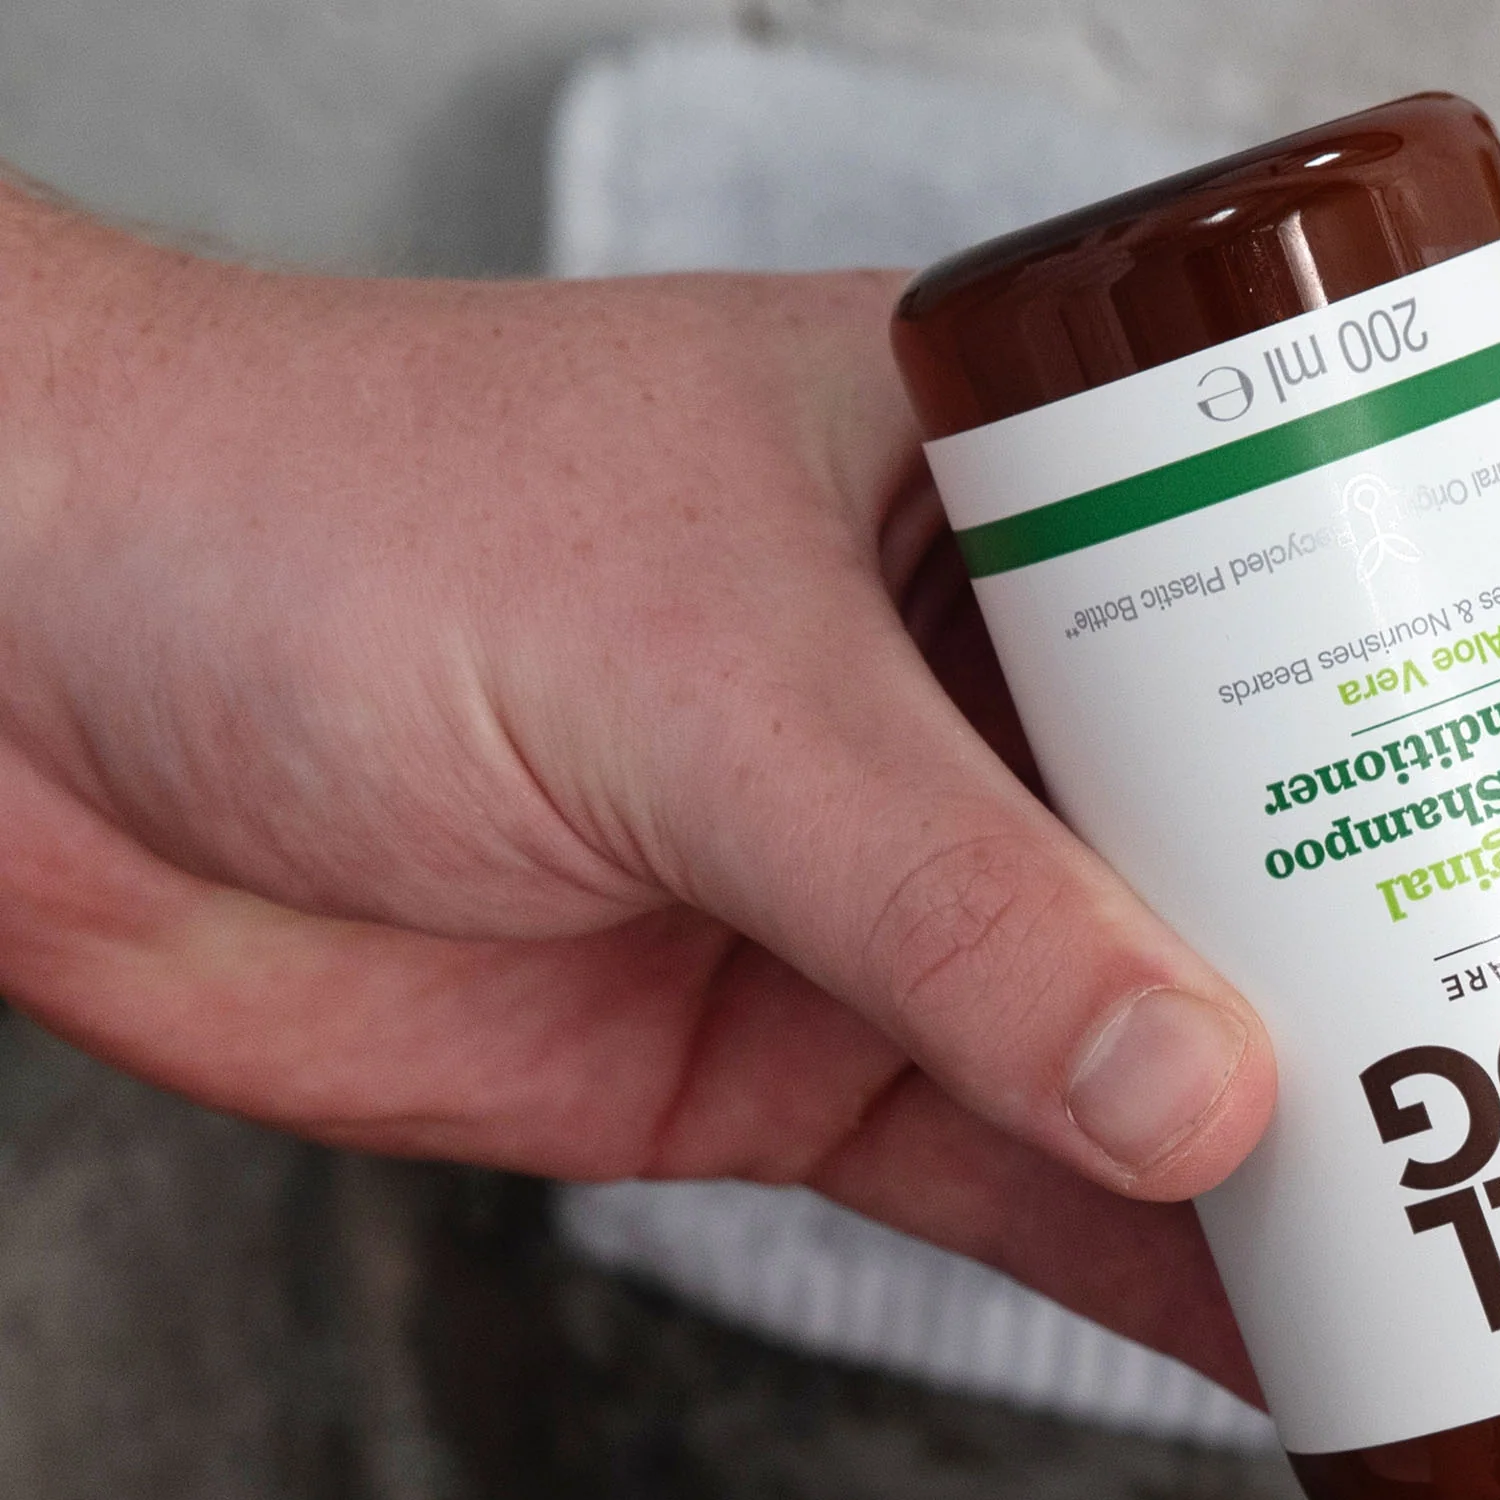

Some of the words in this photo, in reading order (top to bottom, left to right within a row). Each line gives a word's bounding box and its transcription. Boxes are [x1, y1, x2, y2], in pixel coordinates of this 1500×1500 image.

[1338, 298, 1428, 373] 200
[1263, 338, 1327, 403] ml
[1142, 566, 1225, 609] Plastic
[1455, 603, 1474, 624] &
[1318, 614, 1450, 670] Nourishes
[1218, 665, 1313, 705] Beards
[1338, 660, 1429, 706] Vera
